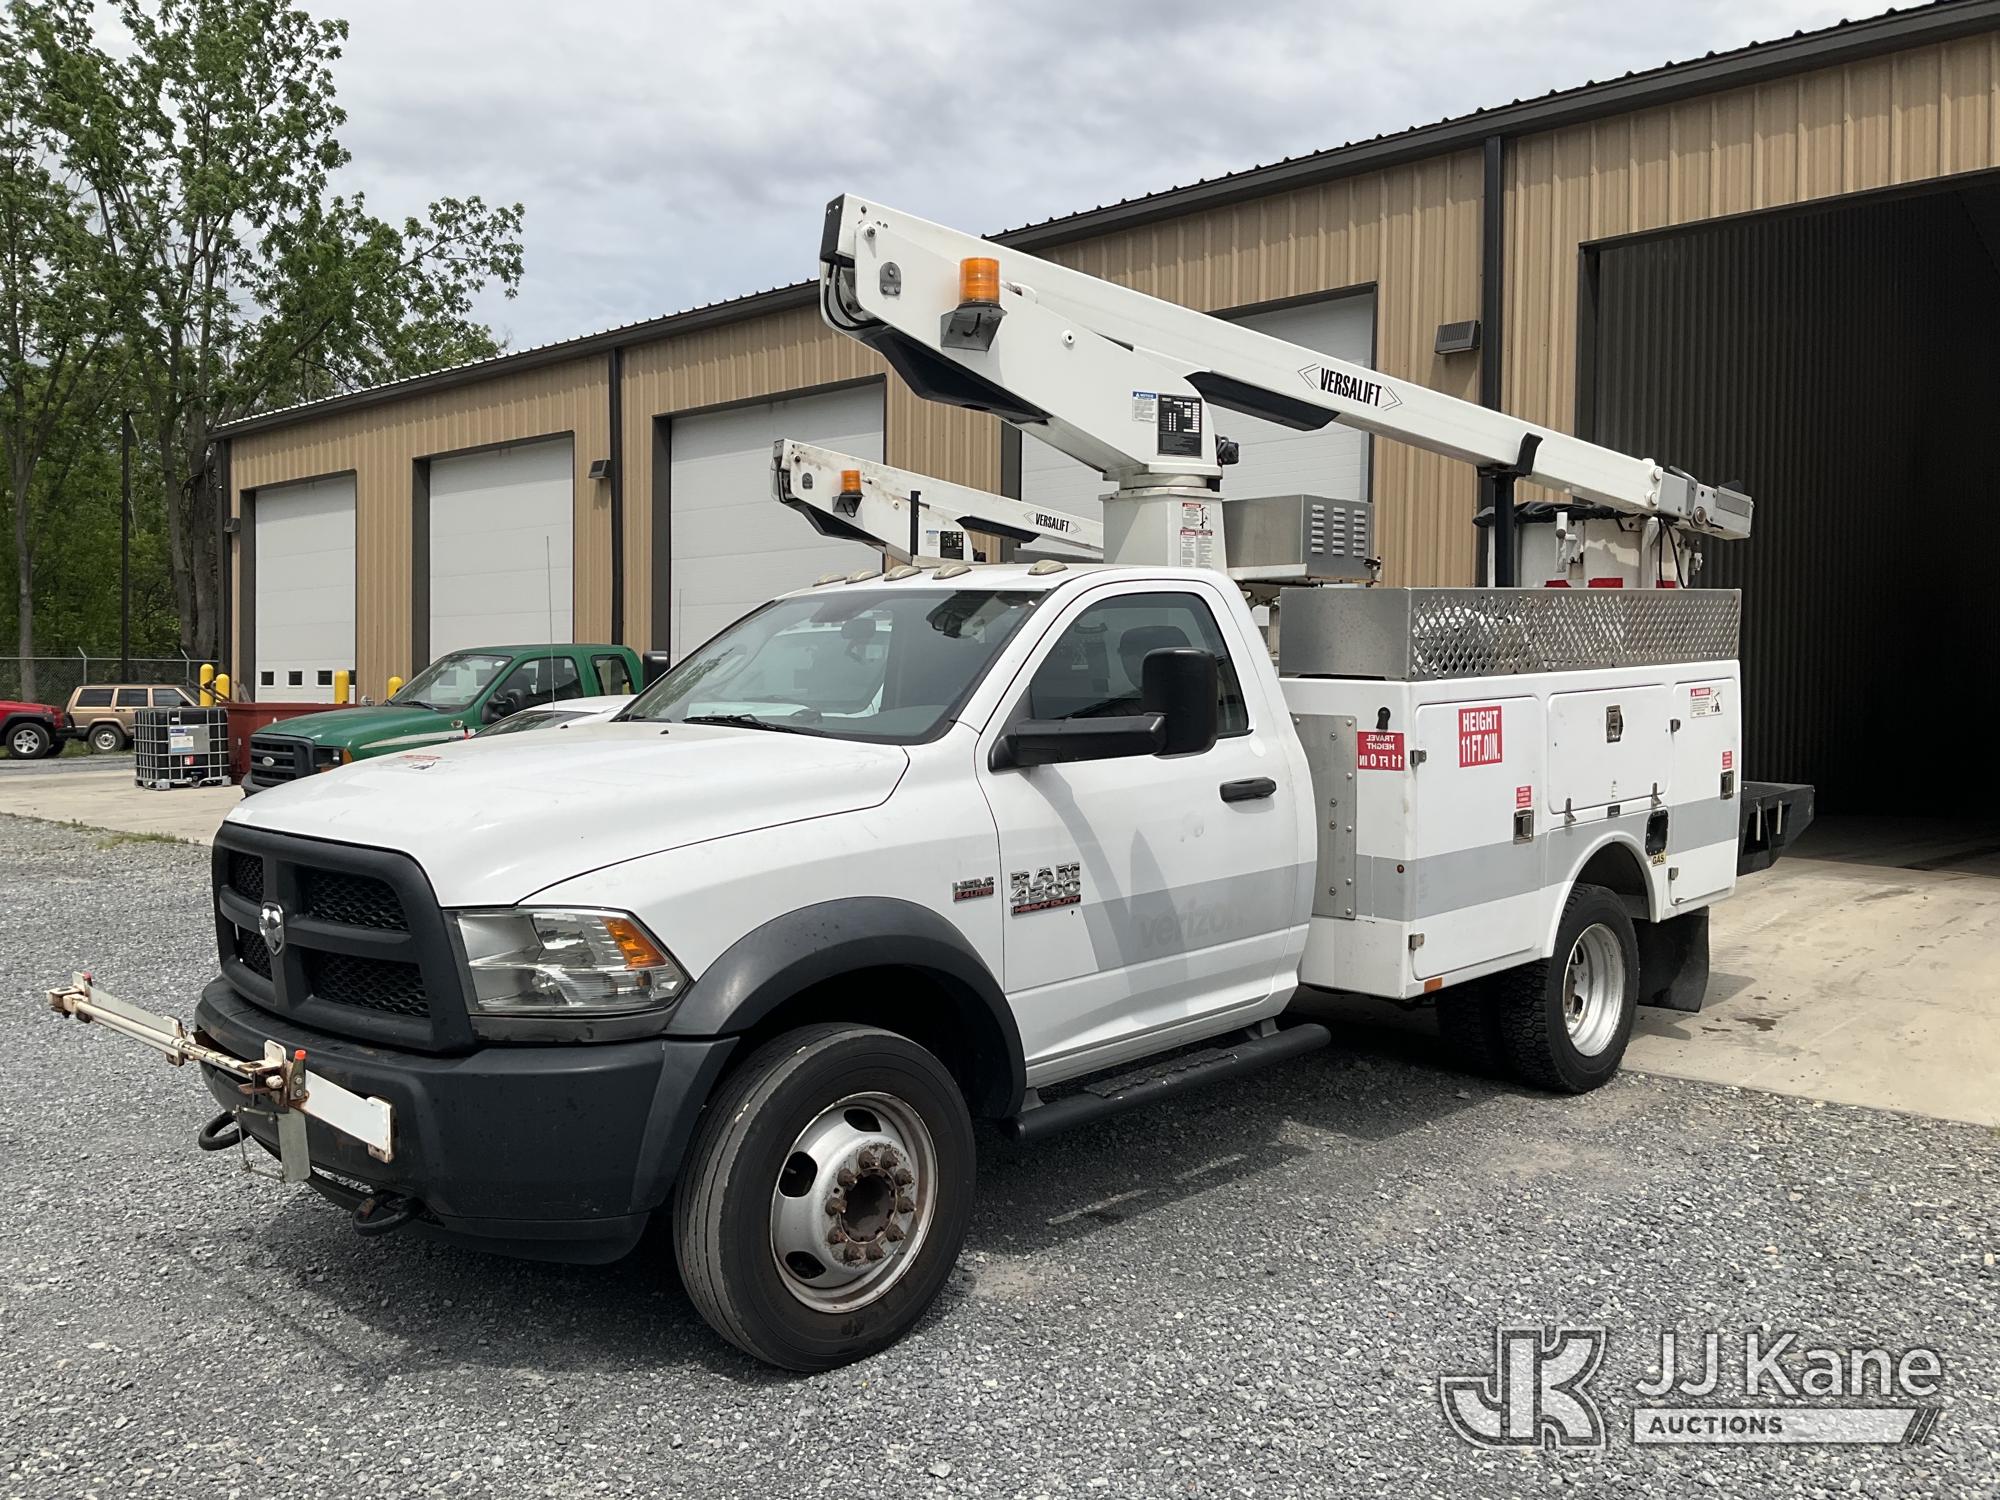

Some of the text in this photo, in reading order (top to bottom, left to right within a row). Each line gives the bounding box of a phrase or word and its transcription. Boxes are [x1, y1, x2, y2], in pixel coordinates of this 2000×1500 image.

[1320, 368, 1382, 407] VERSALIFT
[1035, 513, 1069, 532] VERSALIFT
[1463, 710, 1499, 732] HEIGHT
[1652, 854, 1665, 865] GAS
[1010, 863, 1080, 888] RAM
[1014, 895, 1079, 913] HEAVY DUTY
